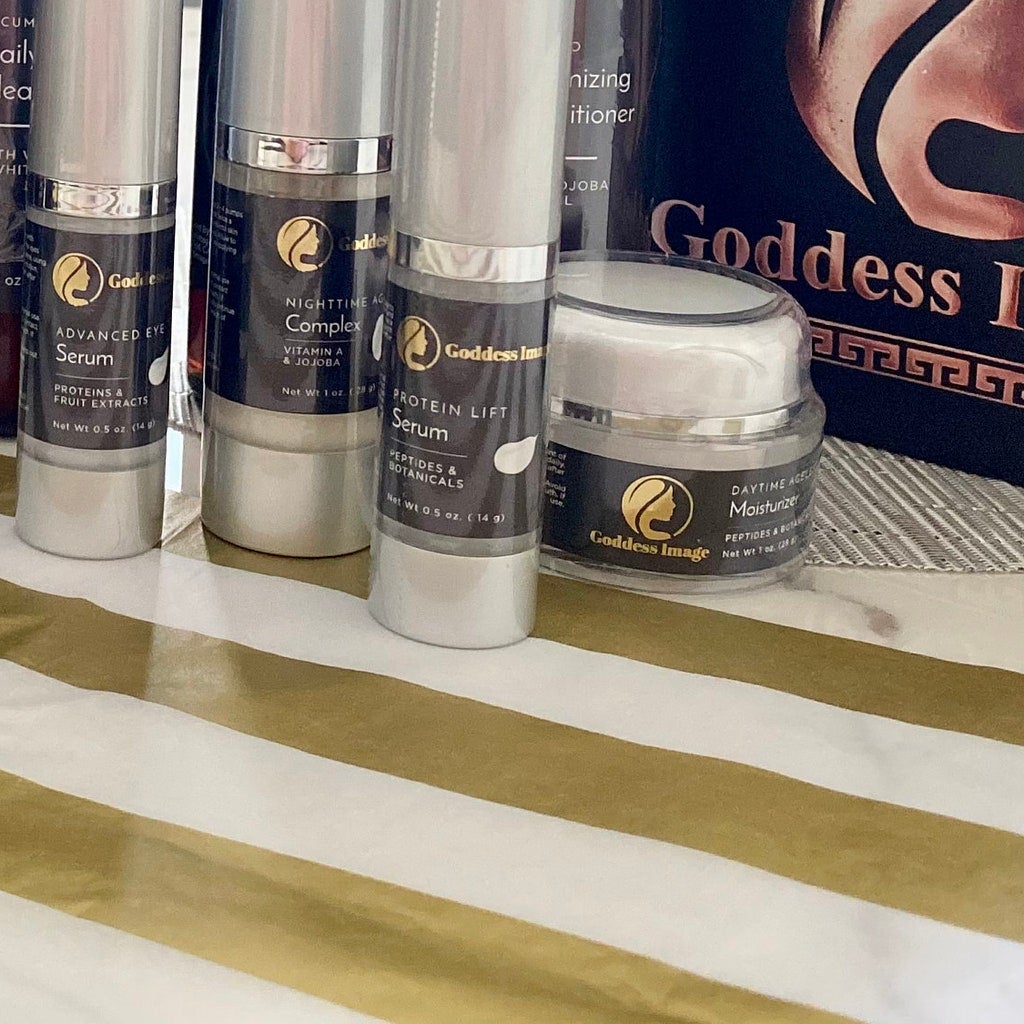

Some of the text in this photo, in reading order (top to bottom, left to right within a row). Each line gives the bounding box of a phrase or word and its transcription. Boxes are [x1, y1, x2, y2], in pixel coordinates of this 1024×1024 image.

[569, 69, 631, 93] nizing
[570, 104, 636, 125] itioner
[650, 198, 962, 316] Goddess
[5, 277, 22, 286] OZ
[285, 295, 368, 310] NIGHTTIME
[56, 323, 166, 342] ADVANCED EYE
[285, 314, 362, 338] Complex
[55, 344, 114, 366] Serum
[283, 346, 343, 357] VITAMIN A
[444, 342, 545, 362] Goddess Ima
[282, 357, 341, 367] & JOJOBA
[54, 384, 124, 398] PROTEINS &
[282, 386, 301, 396] Net
[54, 395, 149, 408] FRUIT EXTRACTS
[393, 387, 461, 417] PROTEIN
[471, 405, 509, 419] LIFT
[53, 419, 71, 432] Net
[392, 407, 449, 442] Serum
[389, 449, 457, 475] PEPTIDES &
[388, 460, 465, 489] BOTANICALS
[731, 478, 786, 496] DAYTIME
[386, 492, 402, 508] Net
[729, 494, 800, 518] Moisturizer
[725, 528, 771, 543] PEPTIDES
[589, 529, 711, 563] Goddess Image
[722, 549, 740, 558] Net
